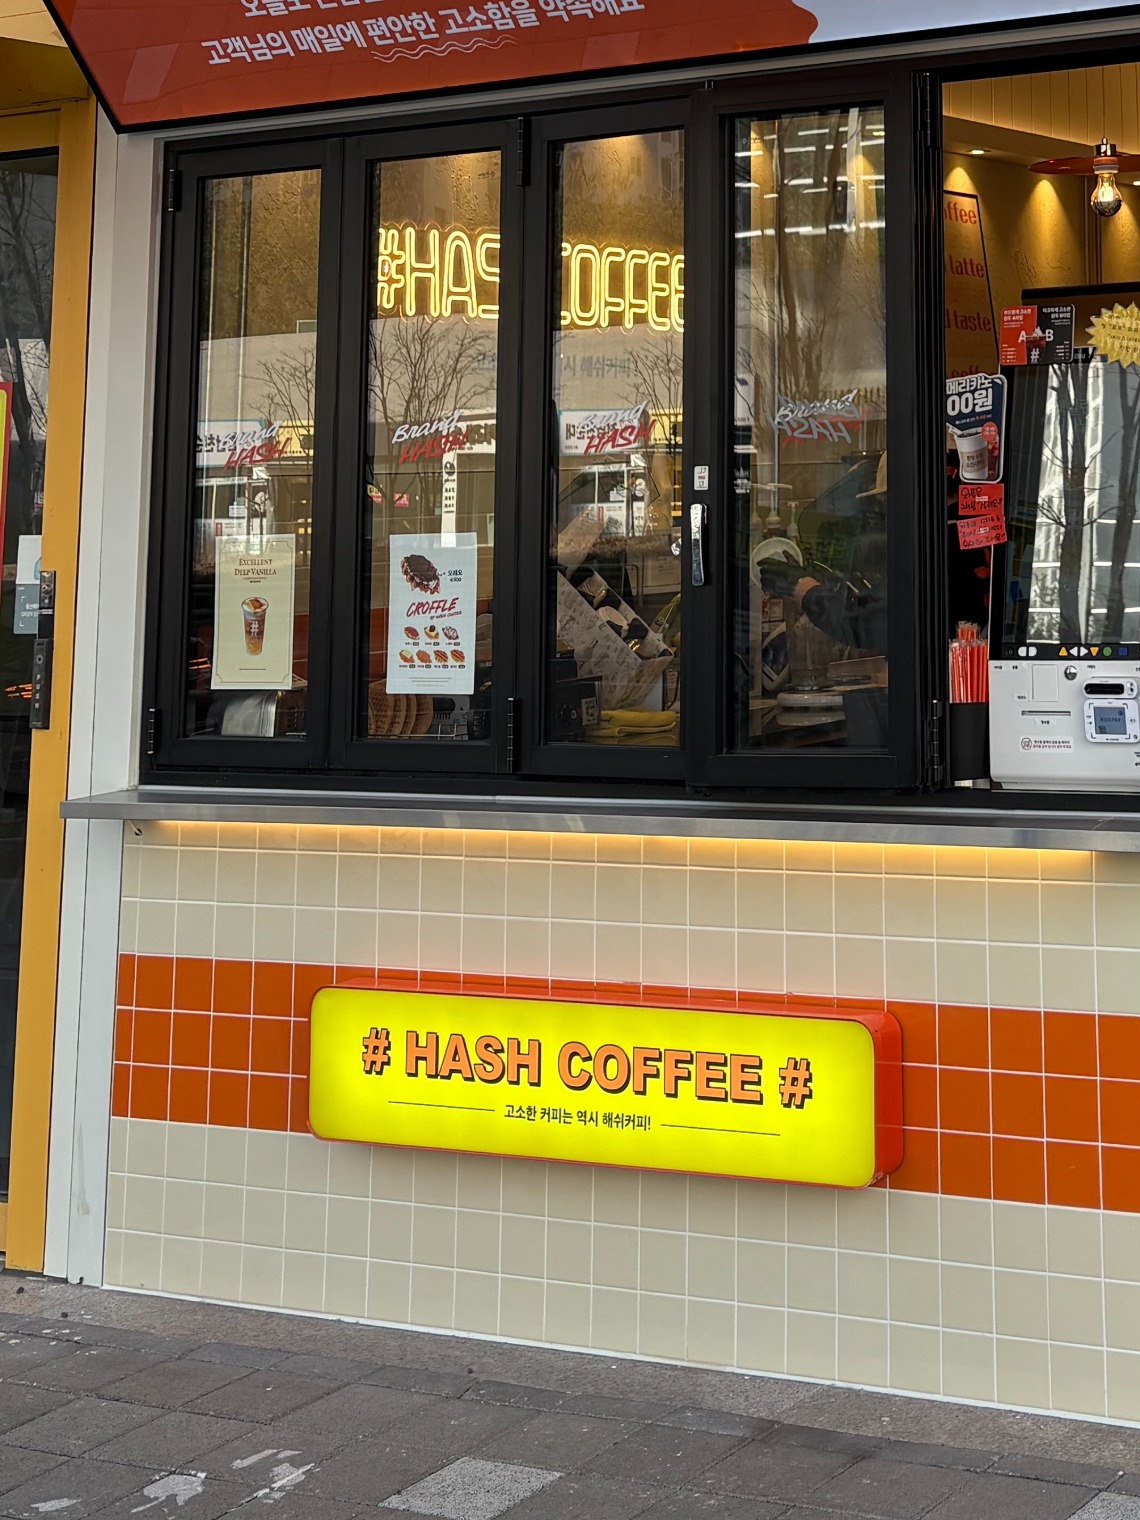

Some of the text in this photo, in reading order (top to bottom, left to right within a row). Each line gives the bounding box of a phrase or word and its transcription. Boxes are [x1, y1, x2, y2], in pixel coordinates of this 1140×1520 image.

[201, 28, 294, 65] 고객님의
[296, 19, 367, 55] 매일에
[367, 10, 437, 44] 편안한
[950, 254, 984, 278] latte
[561, 243, 684, 331] OFFEE
[954, 312, 992, 333] taste
[946, 375, 993, 395] 메리카노
[947, 389, 993, 416] 00원
[392, 408, 464, 444] Brand
[584, 419, 657, 457] HASH
[398, 429, 472, 464] HASH
[406, 597, 460, 618] CROFFLE
[404, 1030, 542, 1087] HASH
[557, 1041, 763, 1106] COFFEE
[504, 1104, 652, 1132] 고소한 커피는 역시 해쉬커피!
